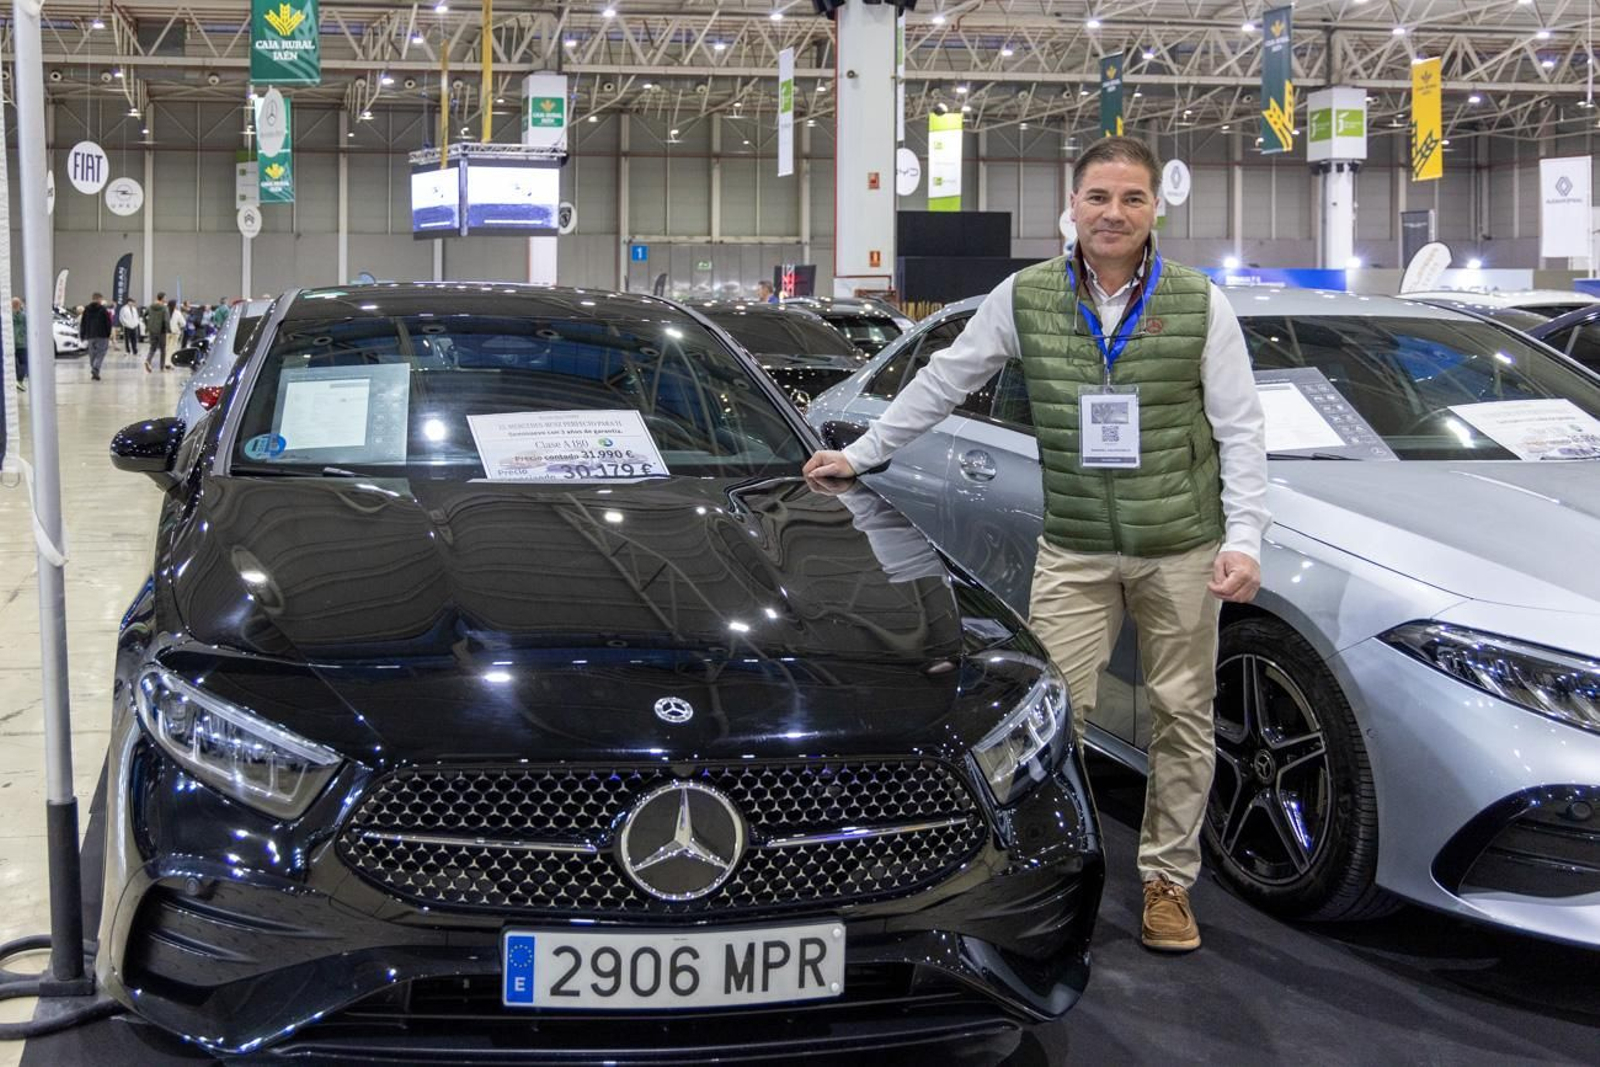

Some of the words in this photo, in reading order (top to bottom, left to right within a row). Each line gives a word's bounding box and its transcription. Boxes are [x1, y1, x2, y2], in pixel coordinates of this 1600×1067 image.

[255, 40, 280, 49] CAJA
[281, 40, 316, 49] RURAL
[74, 152, 103, 183] FIAT
[896, 167, 919, 177] YD
[636, 246, 643, 259] 1
[535, 440, 561, 449] Clase
[563, 440, 571, 449] A
[572, 439, 588, 448] 180
[514, 454, 542, 462] Precio
[544, 453, 579, 461] contado
[581, 449, 623, 459] 31.990
[625, 449, 635, 458] €
[498, 468, 528, 476] Precio
[514, 976, 526, 992] E
[550, 945, 700, 997] 2906
[723, 937, 828, 995] MPR
